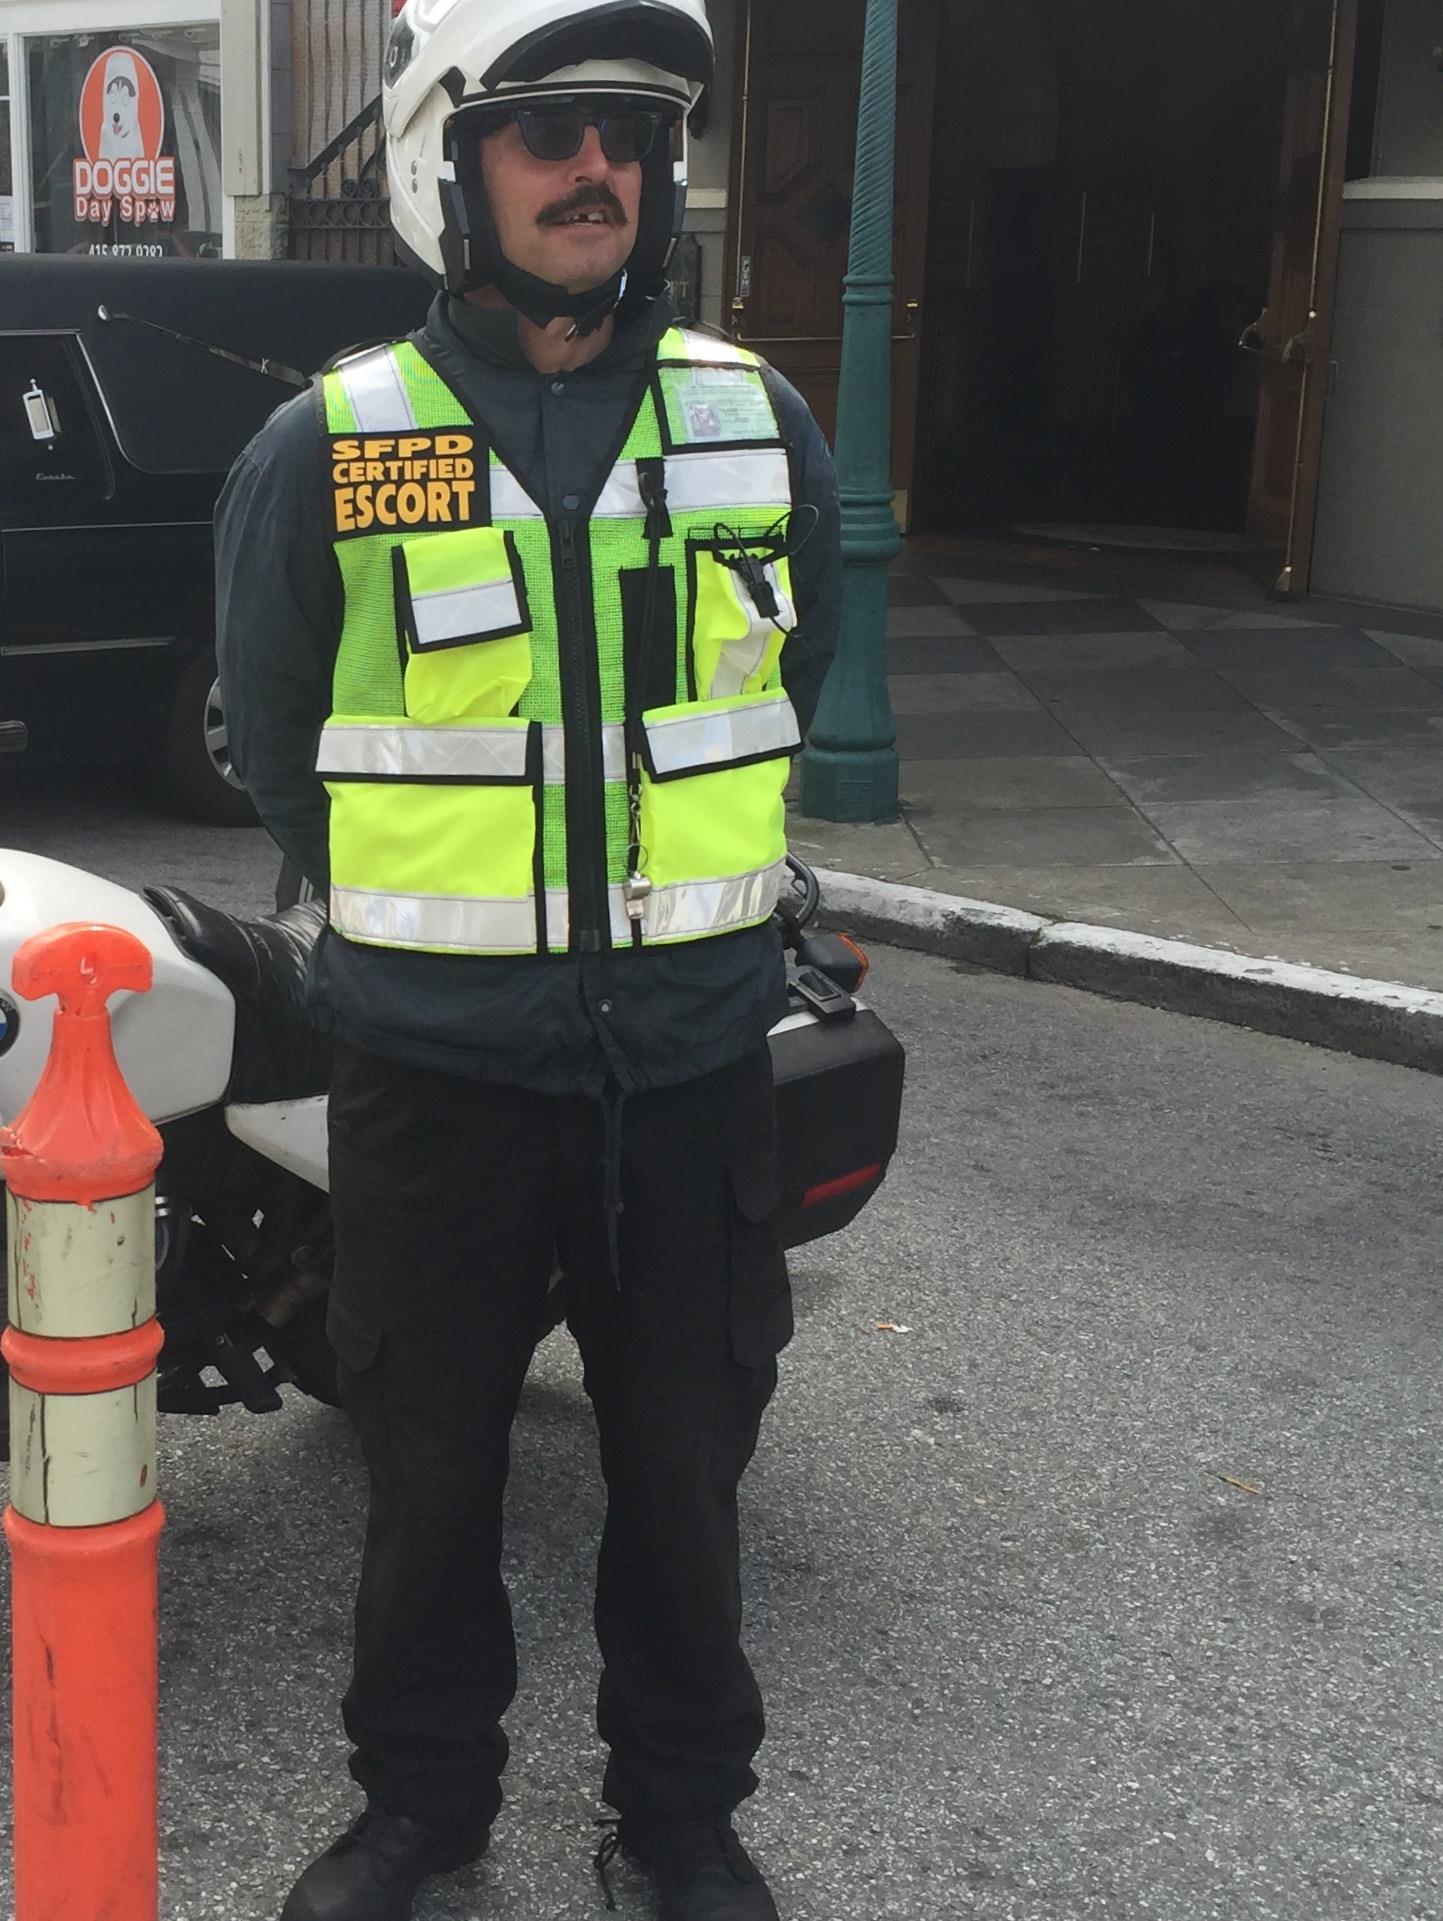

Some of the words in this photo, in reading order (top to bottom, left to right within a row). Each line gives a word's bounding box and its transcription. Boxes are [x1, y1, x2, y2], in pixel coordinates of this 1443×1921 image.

[74, 159, 175, 195] DOGGIE
[76, 196, 111, 222] Day
[332, 435, 474, 460] SFPD
[332, 458, 475, 484] CERTIFIED
[334, 480, 476, 533] ESCORT
